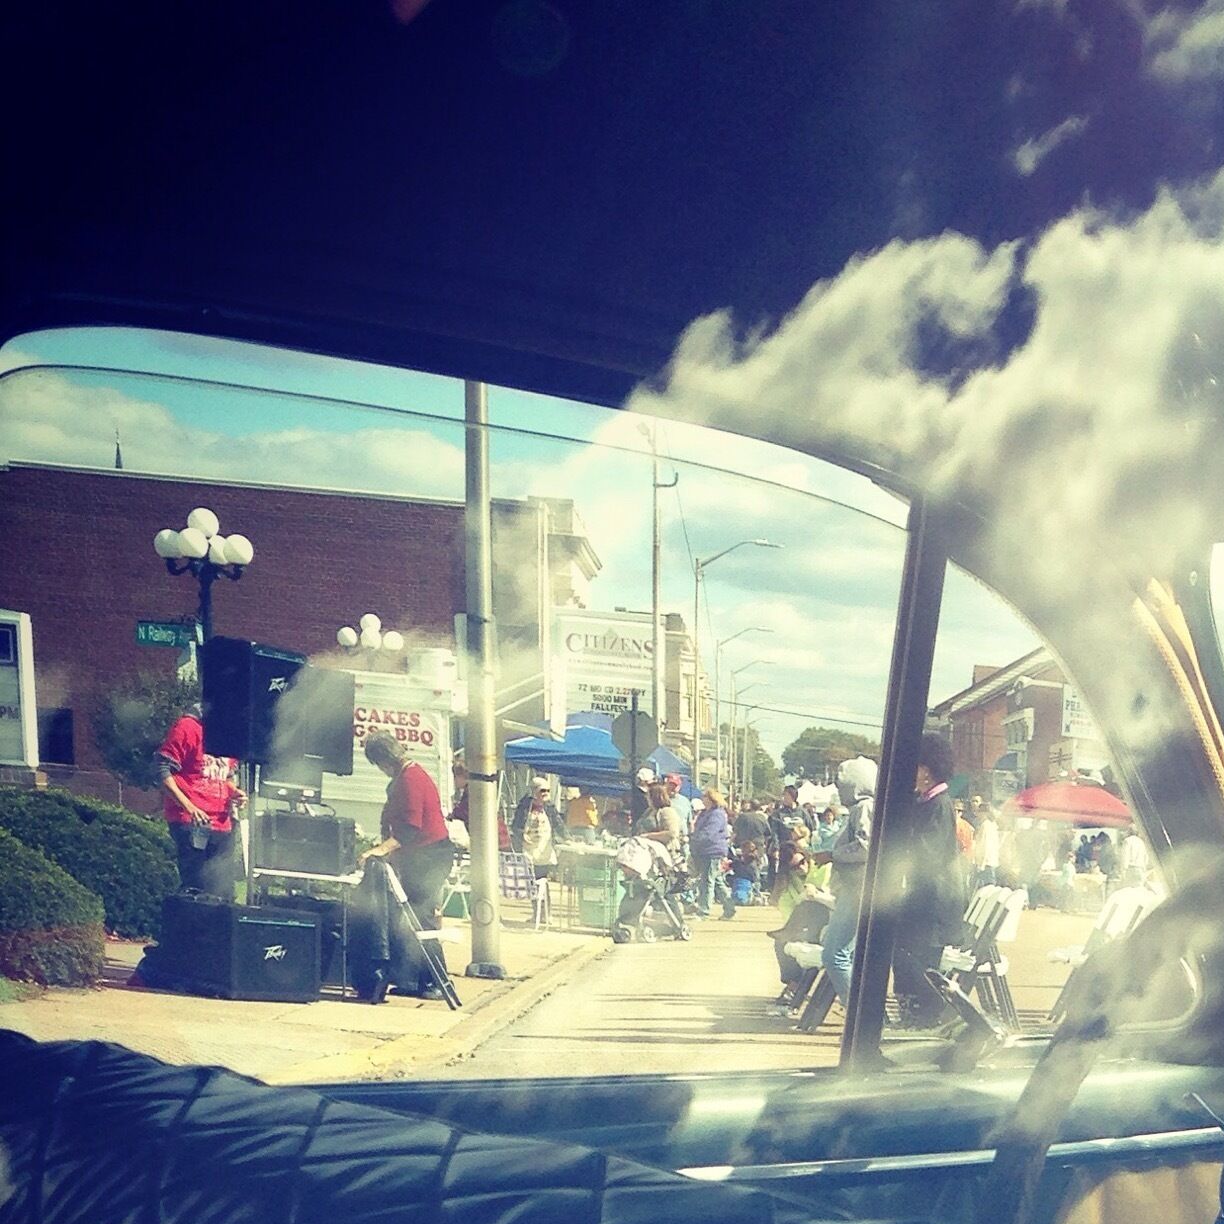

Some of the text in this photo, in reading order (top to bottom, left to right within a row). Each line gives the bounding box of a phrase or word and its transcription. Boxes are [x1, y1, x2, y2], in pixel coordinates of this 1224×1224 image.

[138, 626, 146, 640] N
[565, 632, 654, 659] CITIZENS
[395, 728, 434, 747] BBQ
